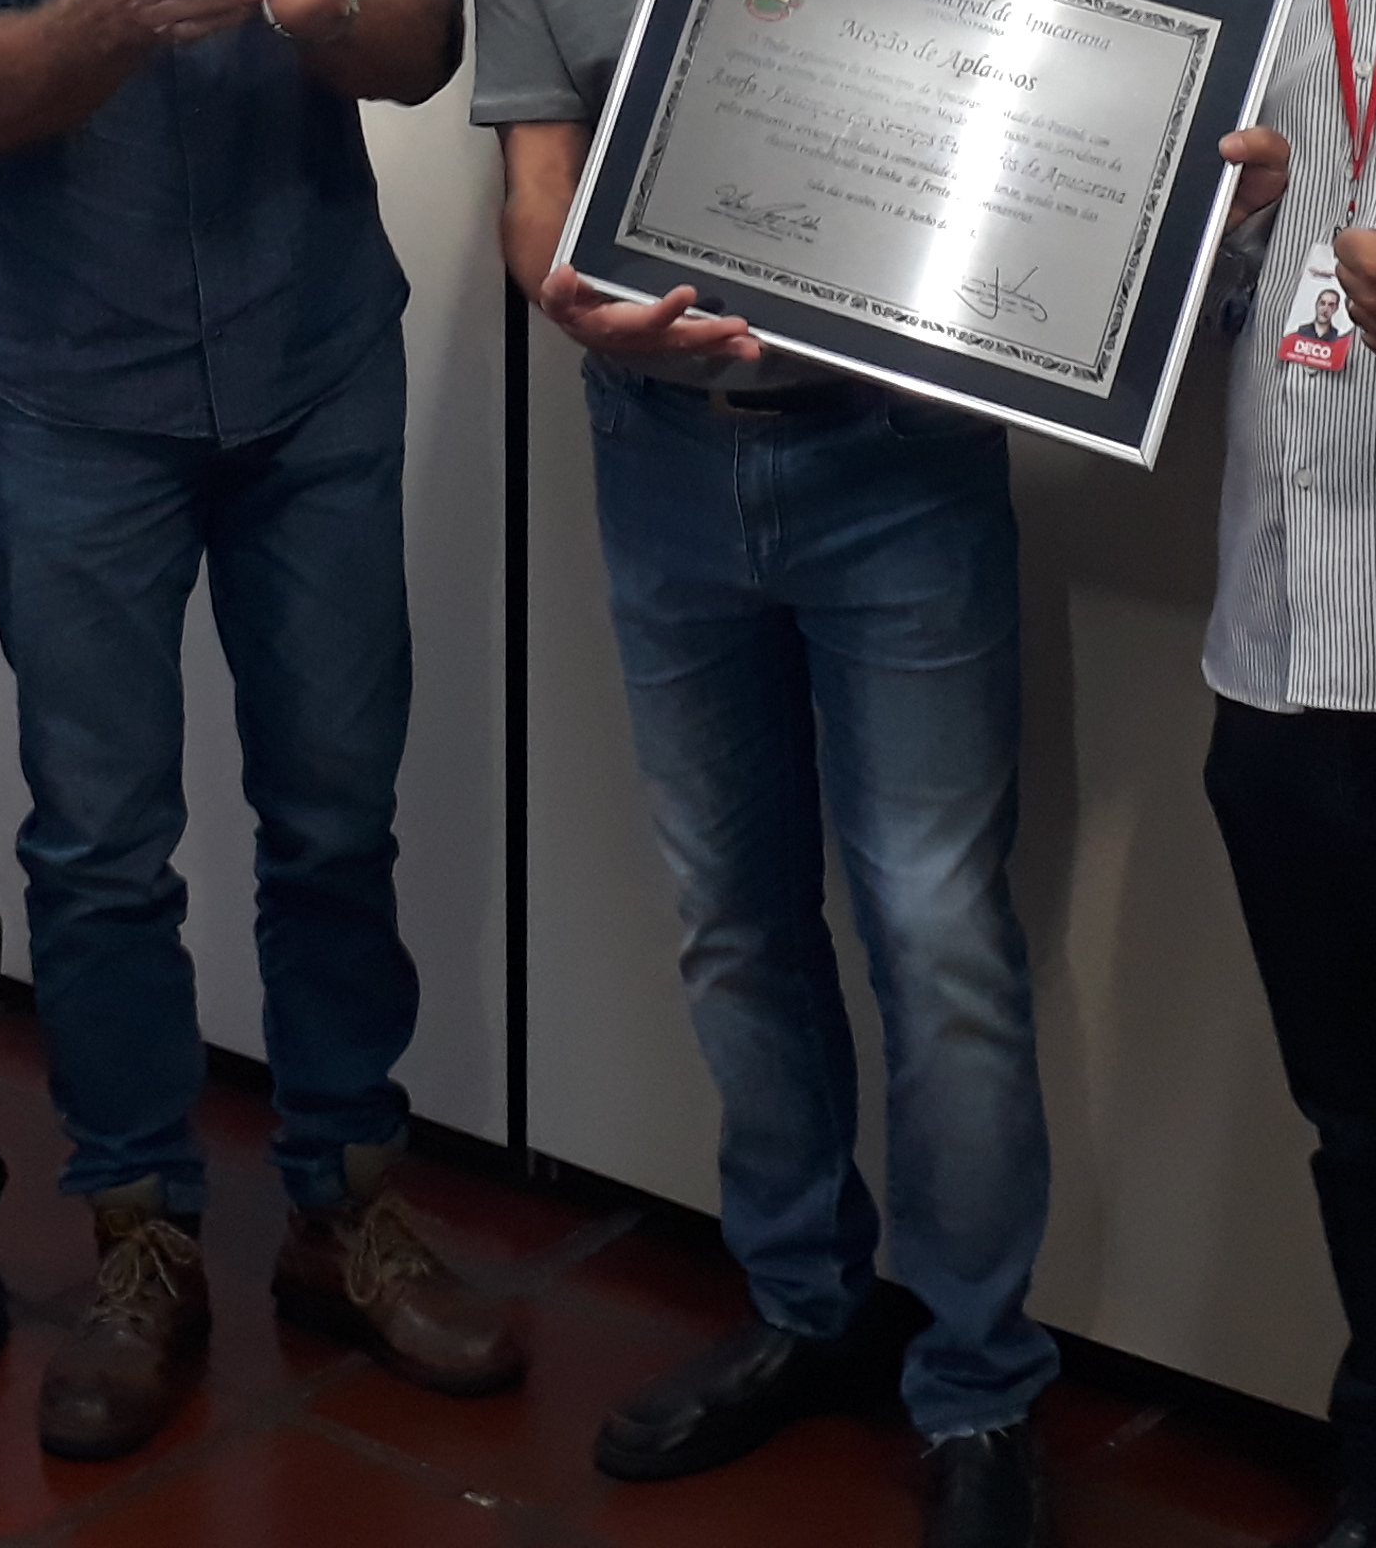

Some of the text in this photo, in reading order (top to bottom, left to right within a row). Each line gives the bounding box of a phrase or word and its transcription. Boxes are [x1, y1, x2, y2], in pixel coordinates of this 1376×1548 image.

[838, 18, 909, 54] Moção
[912, 37, 939, 62] de
[1293, 338, 1332, 360] DECO
